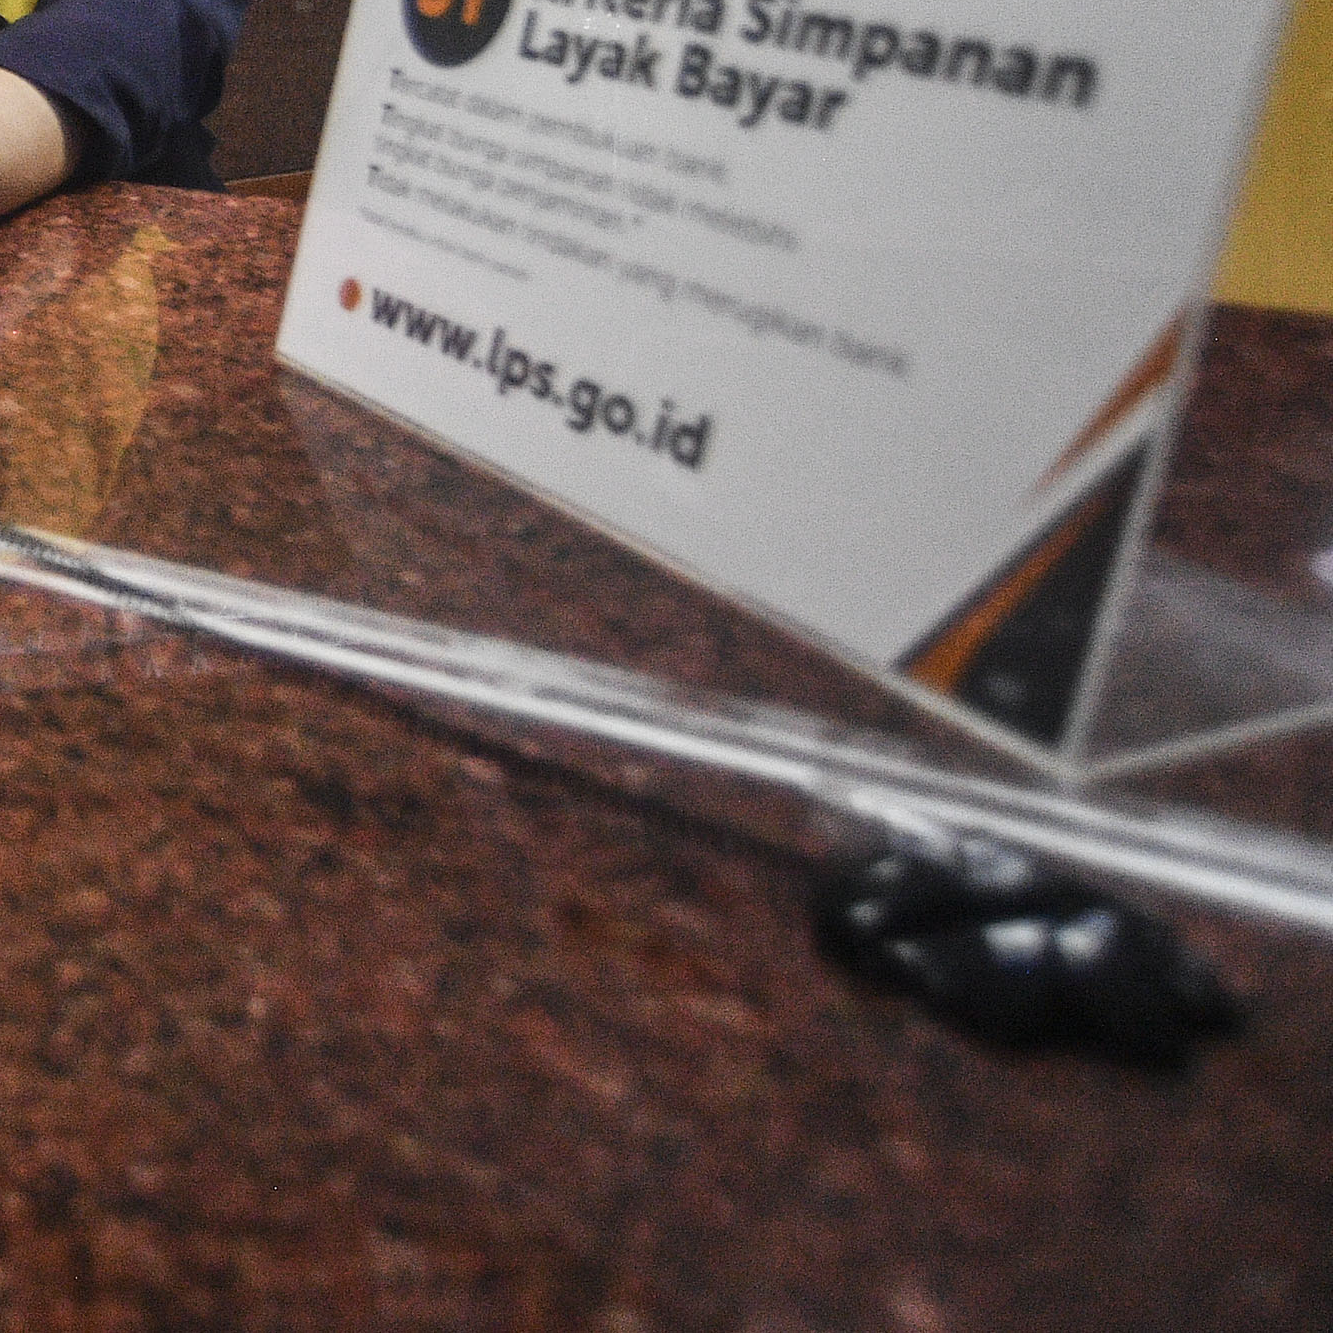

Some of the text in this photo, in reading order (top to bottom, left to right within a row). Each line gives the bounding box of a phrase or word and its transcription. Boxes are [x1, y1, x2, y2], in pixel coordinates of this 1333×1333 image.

[517, 8, 663, 89] Layak
[674, 42, 853, 131] Bayar
[370, 283, 714, 471] www.lps.go.id
